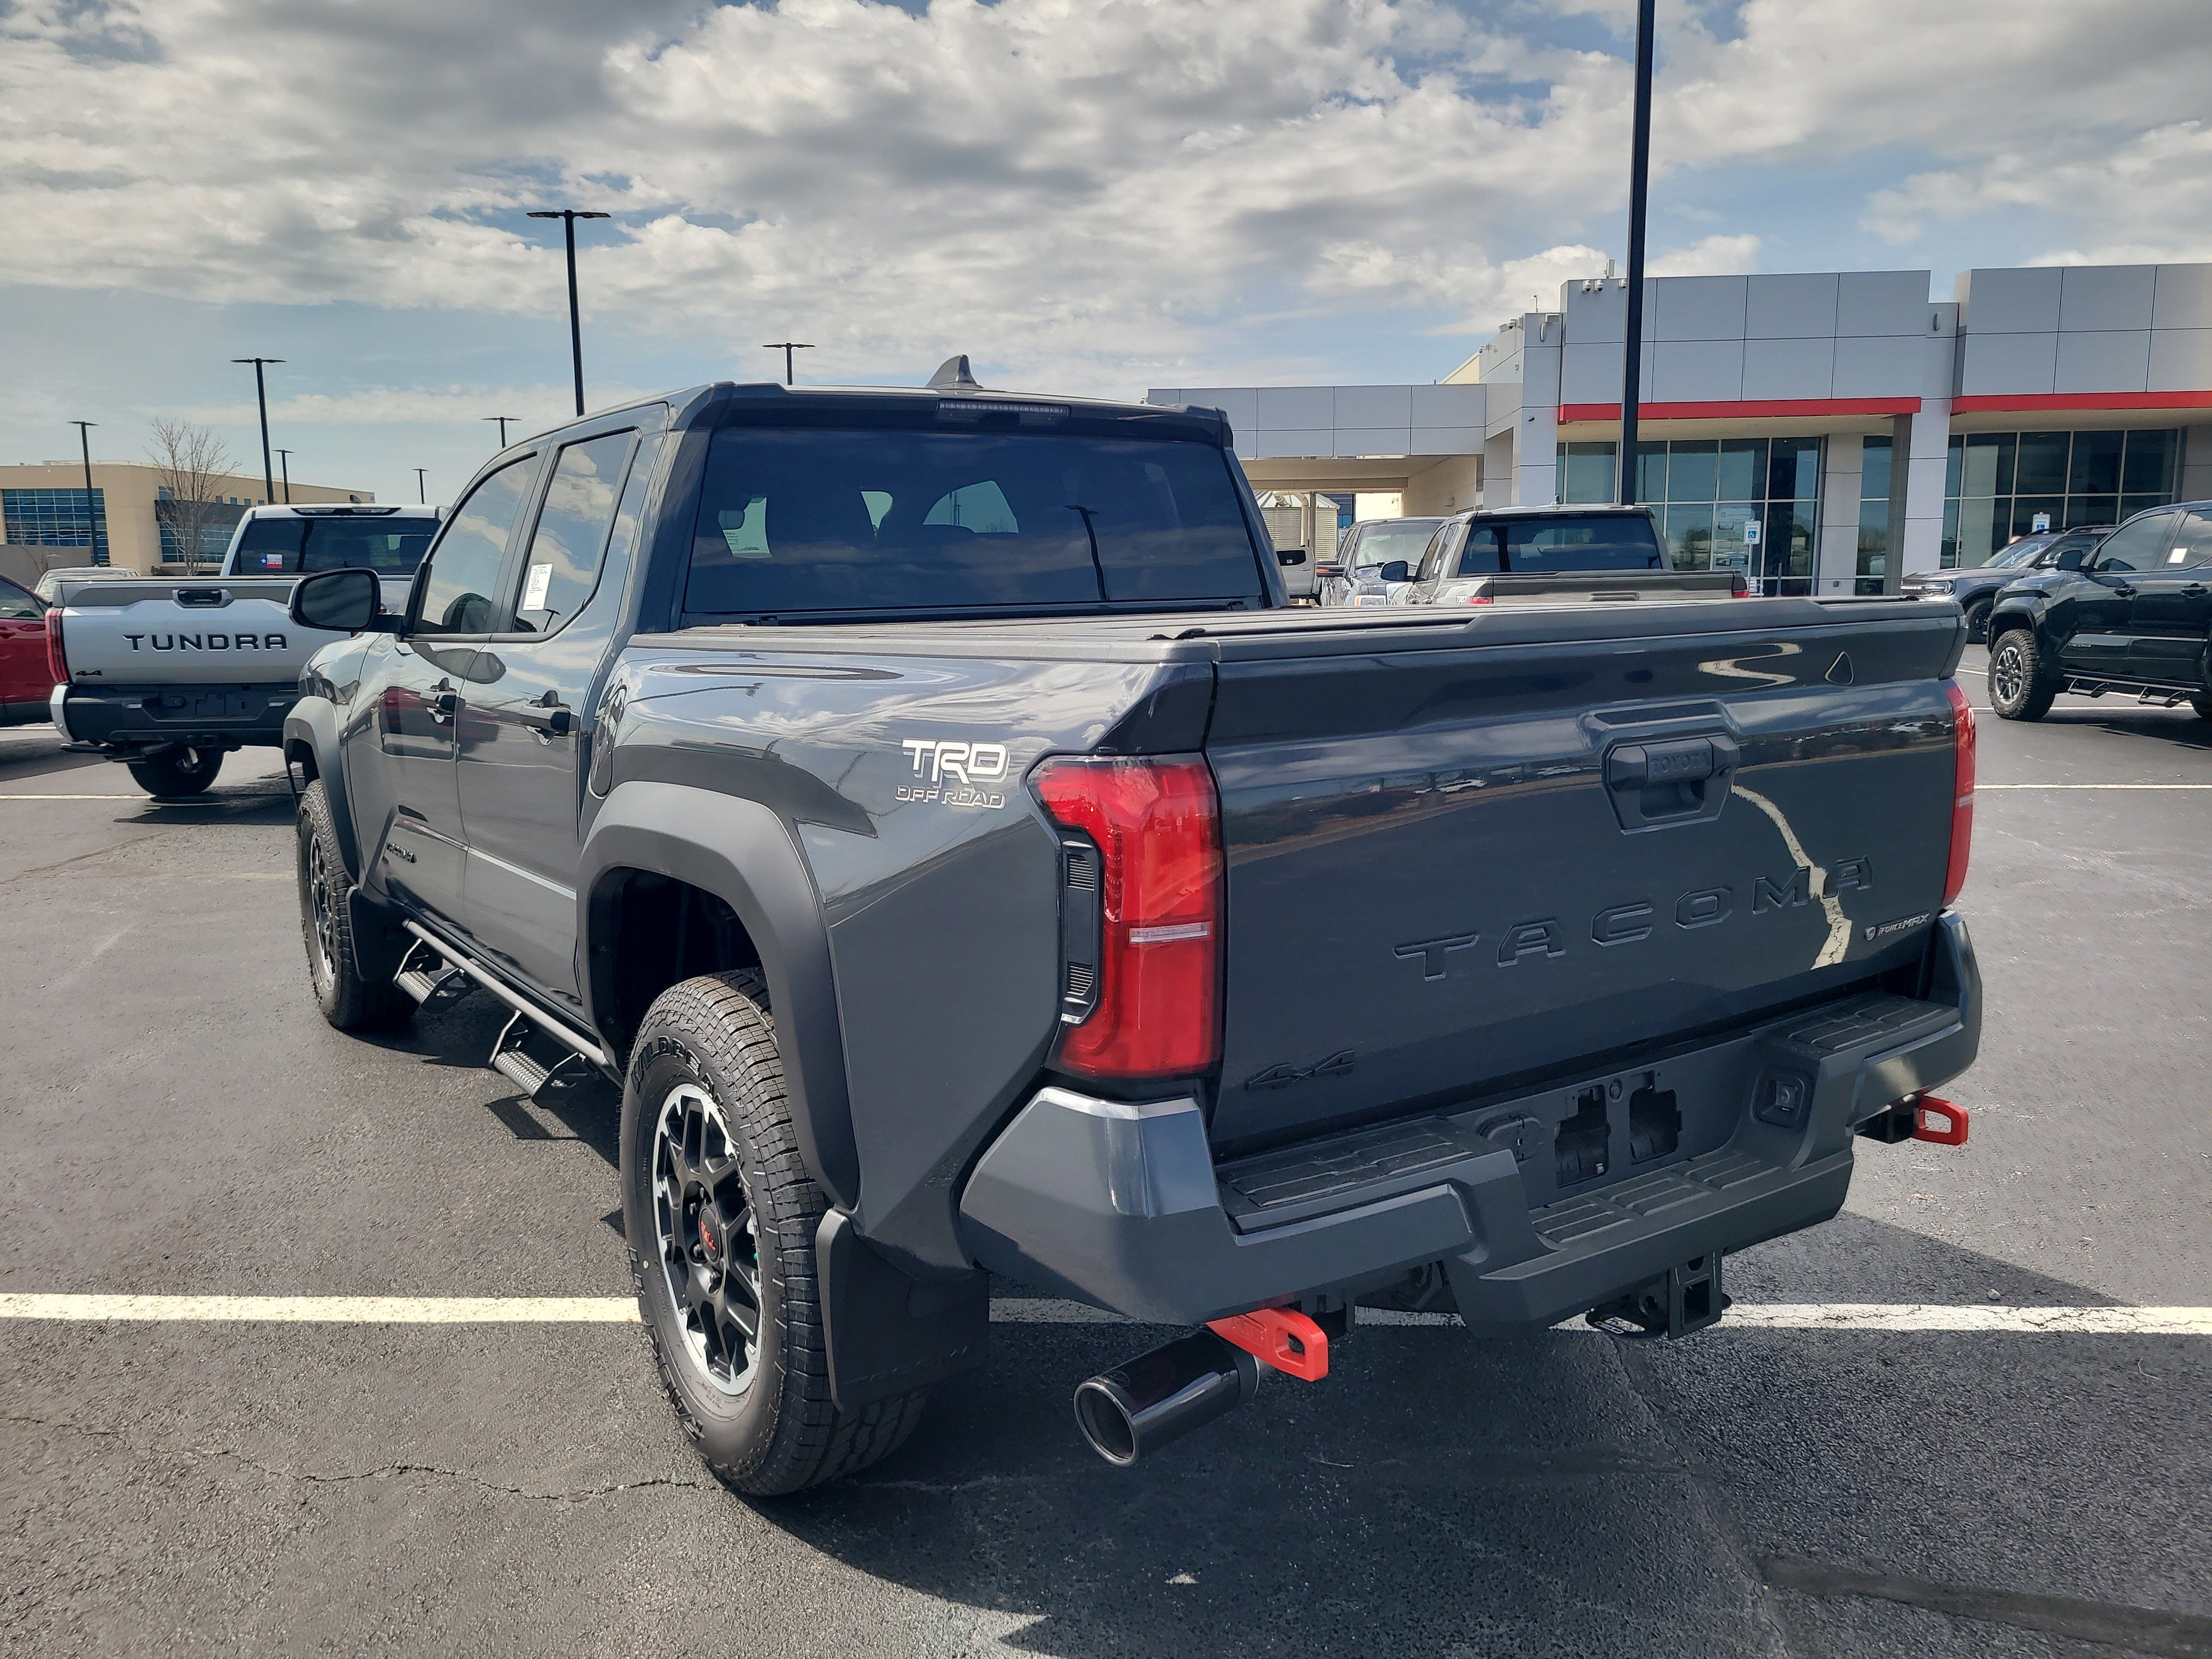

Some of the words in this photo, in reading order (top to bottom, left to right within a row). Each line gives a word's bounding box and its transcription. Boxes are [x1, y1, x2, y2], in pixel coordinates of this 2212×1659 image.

[122, 633, 289, 652] TUNDRA
[902, 738, 1010, 786] TRD
[1650, 752, 1710, 775] TOYOTA
[895, 785, 939, 803] OFF
[940, 788, 1006, 809] ROAD
[1392, 855, 1873, 982] TACOMA
